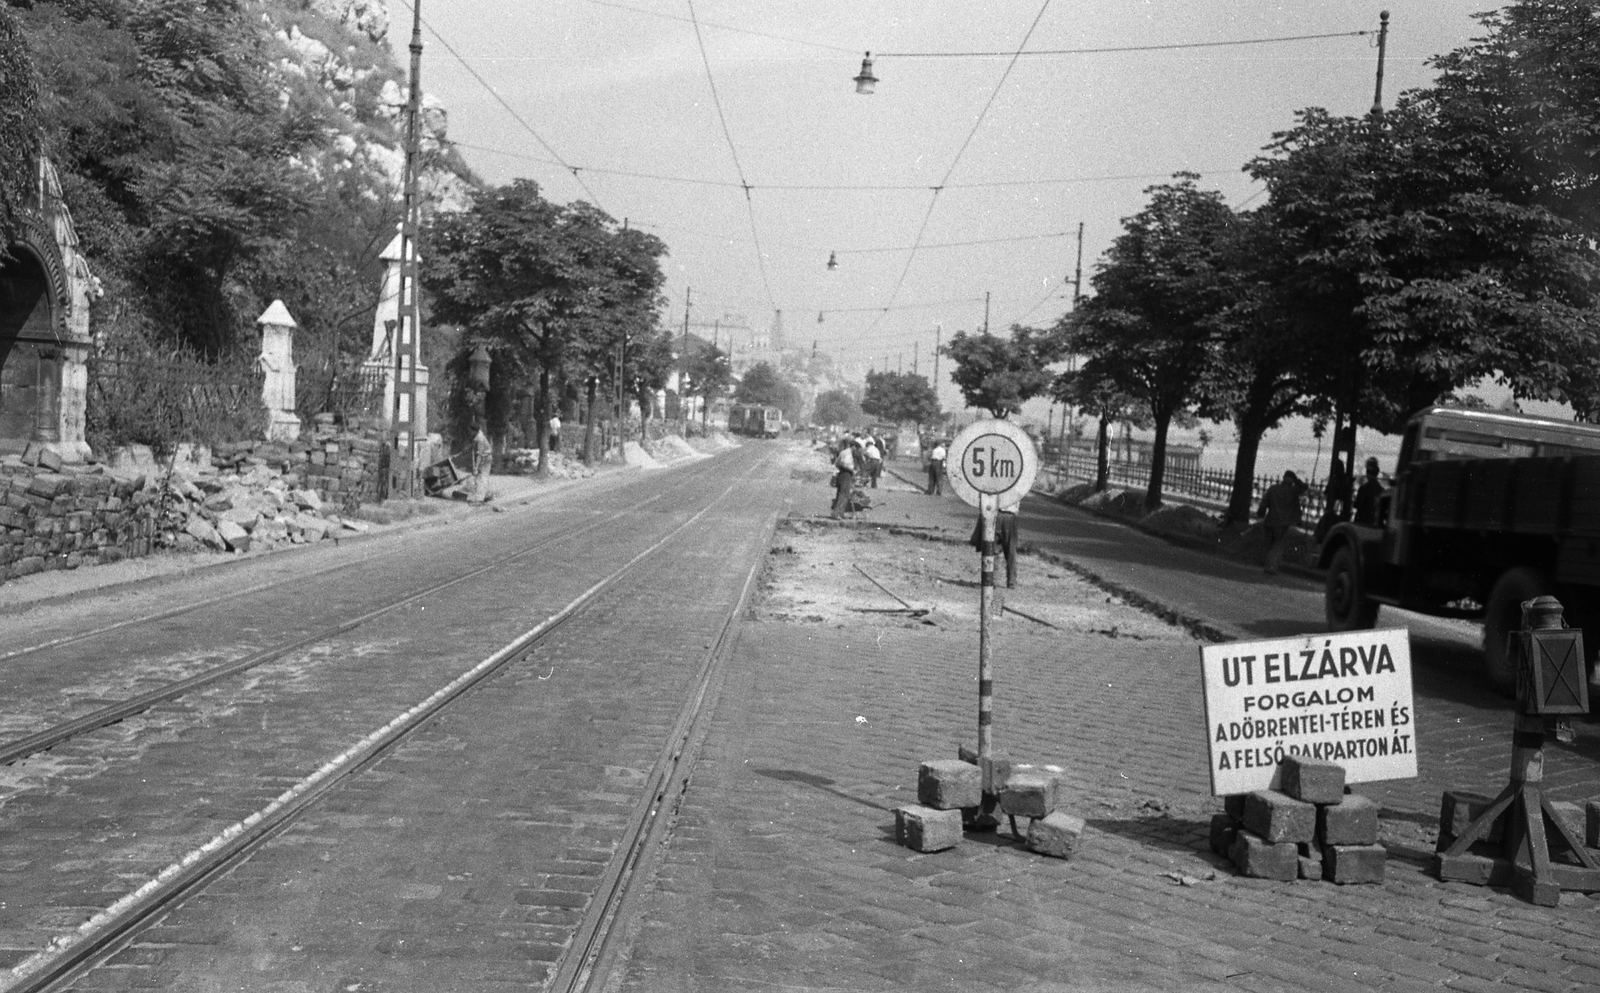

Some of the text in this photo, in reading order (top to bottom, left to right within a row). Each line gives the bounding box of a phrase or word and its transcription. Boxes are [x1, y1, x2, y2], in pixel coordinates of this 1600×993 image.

[972, 446, 1014, 477] 5 km
[1222, 639, 1396, 687] UT ELZÁRVA
[1244, 686, 1374, 712] FORGALOM
[1216, 723, 1228, 742] A
[1391, 700, 1410, 726] ÉS
[1218, 751, 1231, 770] A
[1391, 729, 1412, 755] ÁT.
